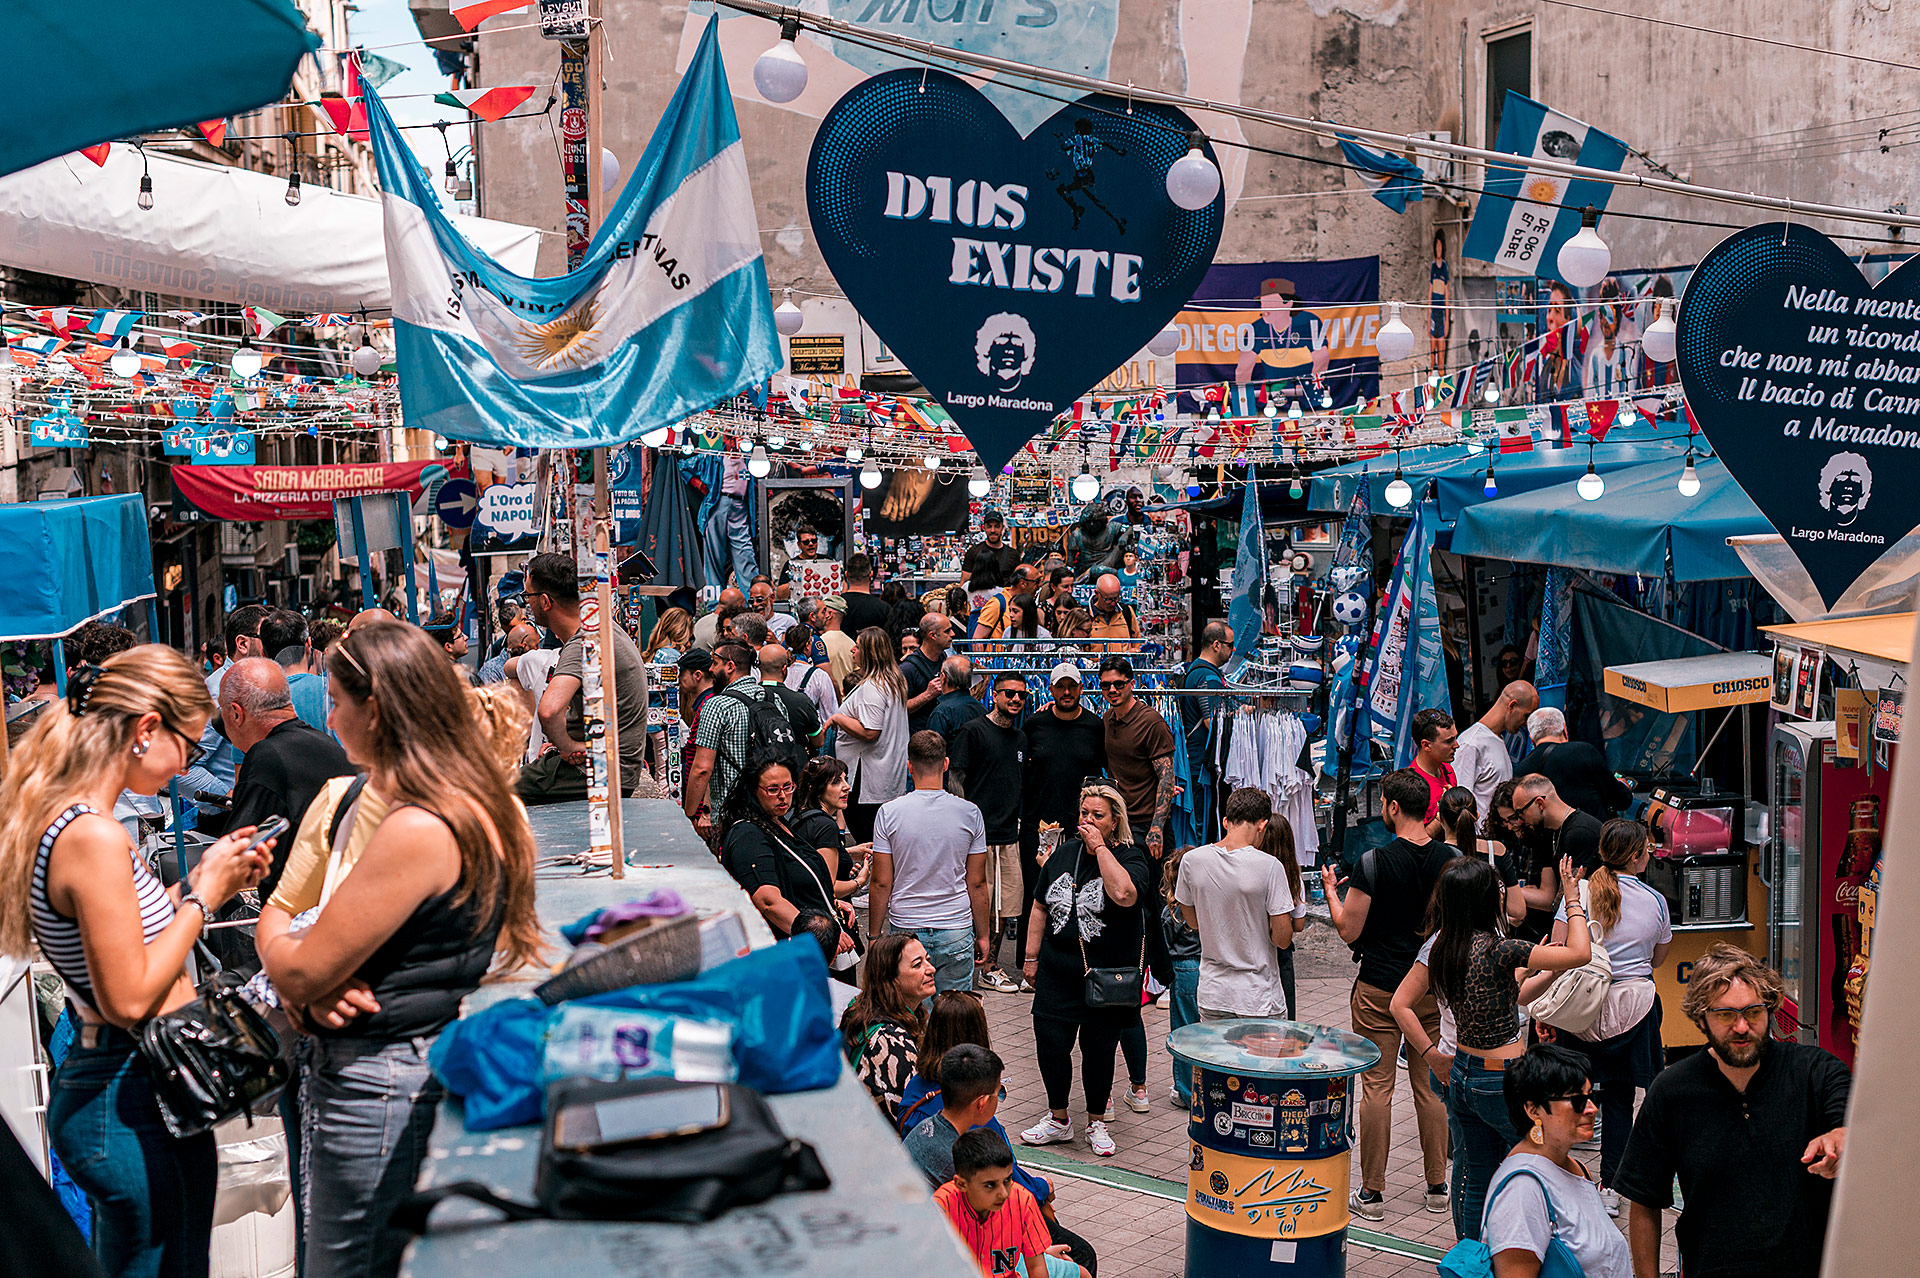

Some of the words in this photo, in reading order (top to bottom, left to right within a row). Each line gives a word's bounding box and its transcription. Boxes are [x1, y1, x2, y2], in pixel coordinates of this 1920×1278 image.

[948, 236, 1144, 303] EXISTE
[1783, 284, 1850, 314] Nella
[1176, 323, 1255, 353] DIEGO
[1309, 314, 1379, 351] VIVE
[1807, 325, 1839, 345] un
[1845, 323, 1920, 353] ricord
[1719, 345, 1762, 370] che
[1766, 353, 1813, 375] non
[1817, 354, 1852, 378] mi
[947, 391, 986, 408] Largo
[988, 394, 1053, 412] Maradona
[1760, 380, 1825, 408] bacio
[1830, 386, 1857, 410] di
[1783, 419, 1801, 437] a
[1809, 416, 1920, 449] Maradon
[234, 492, 250, 504] LA
[253, 490, 310, 504] PIZZERIA
[490, 495, 523, 507] L'Oro
[491, 509, 533, 522] NAPOL
[1791, 526, 1825, 542] Largo
[1827, 529, 1885, 544] Maradona
[1247, 1202, 1319, 1225] DIEGO
[1278, 1216, 1296, 1236] (10)
